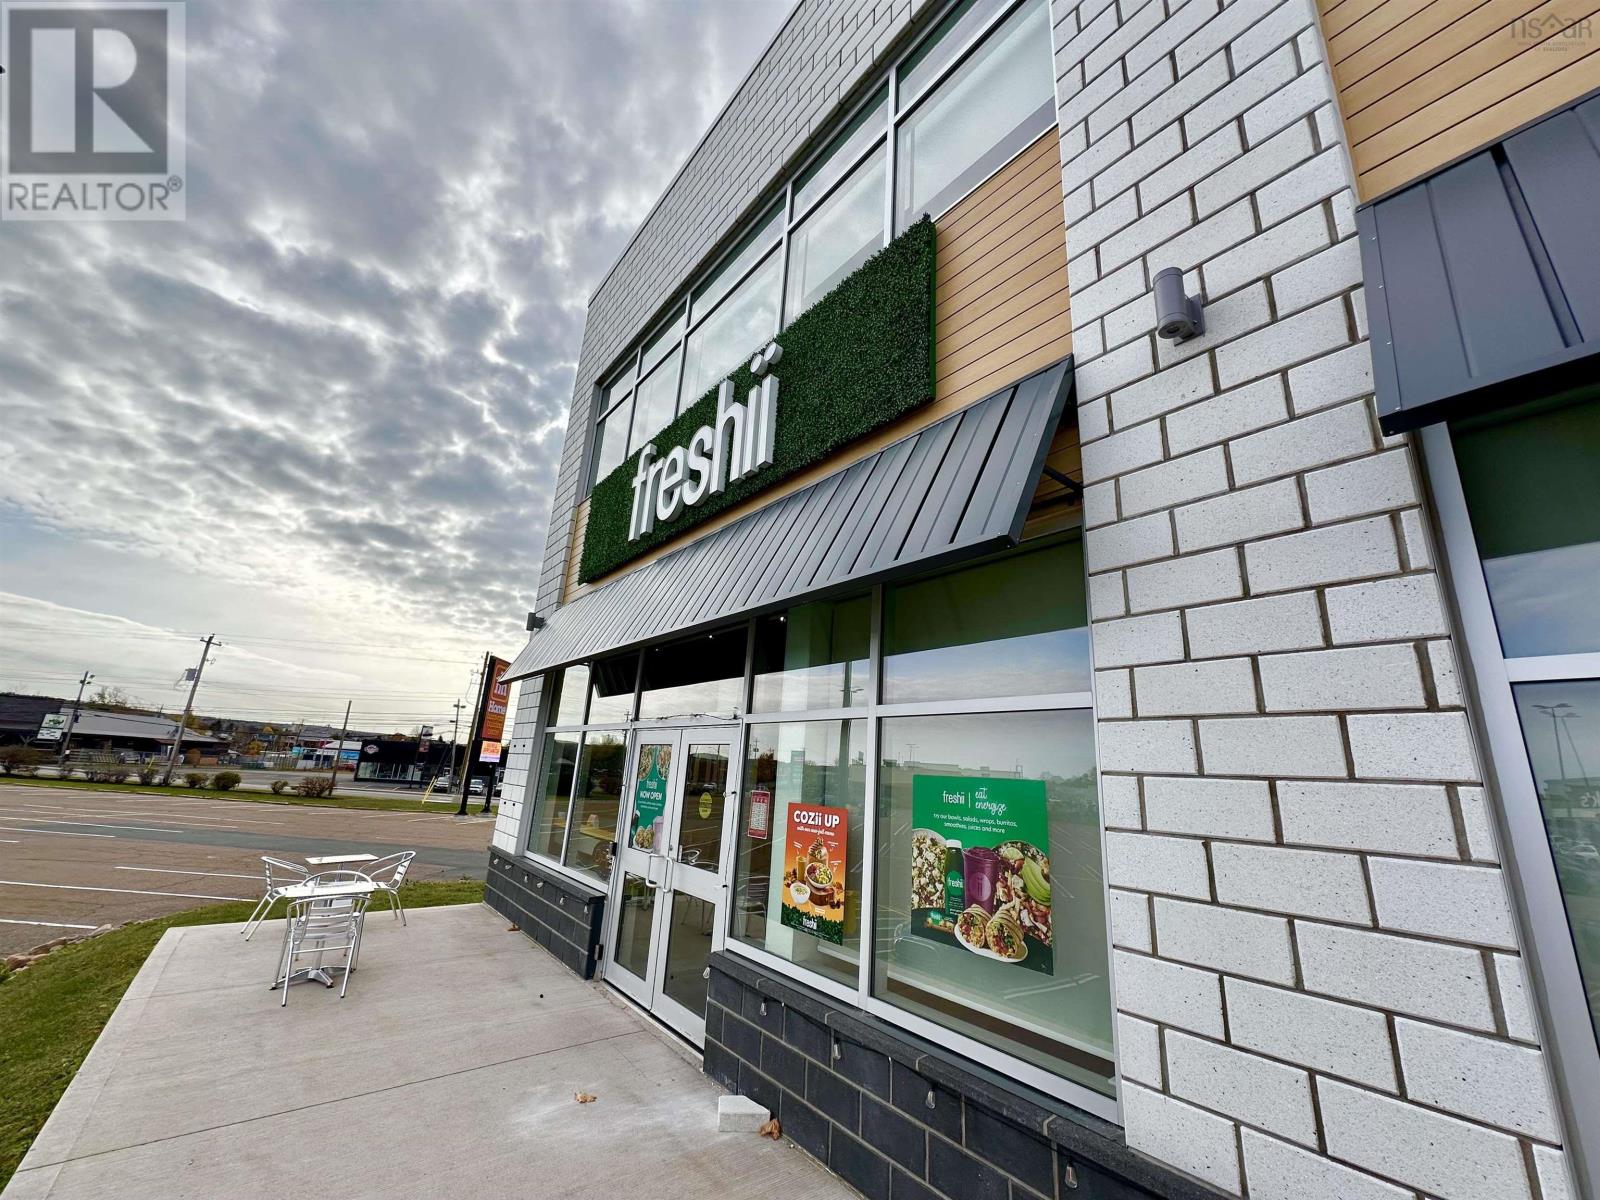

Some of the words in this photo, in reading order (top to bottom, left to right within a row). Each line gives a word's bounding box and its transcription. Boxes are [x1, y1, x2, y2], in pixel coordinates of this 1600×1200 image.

[628, 341, 783, 542] freshii
[640, 791, 650, 799] NOW
[650, 792, 662, 800] OPEN
[943, 790, 965, 804] freshii
[975, 787, 988, 799] eat
[975, 802, 1007, 815] energize
[824, 814, 840, 828] UP
